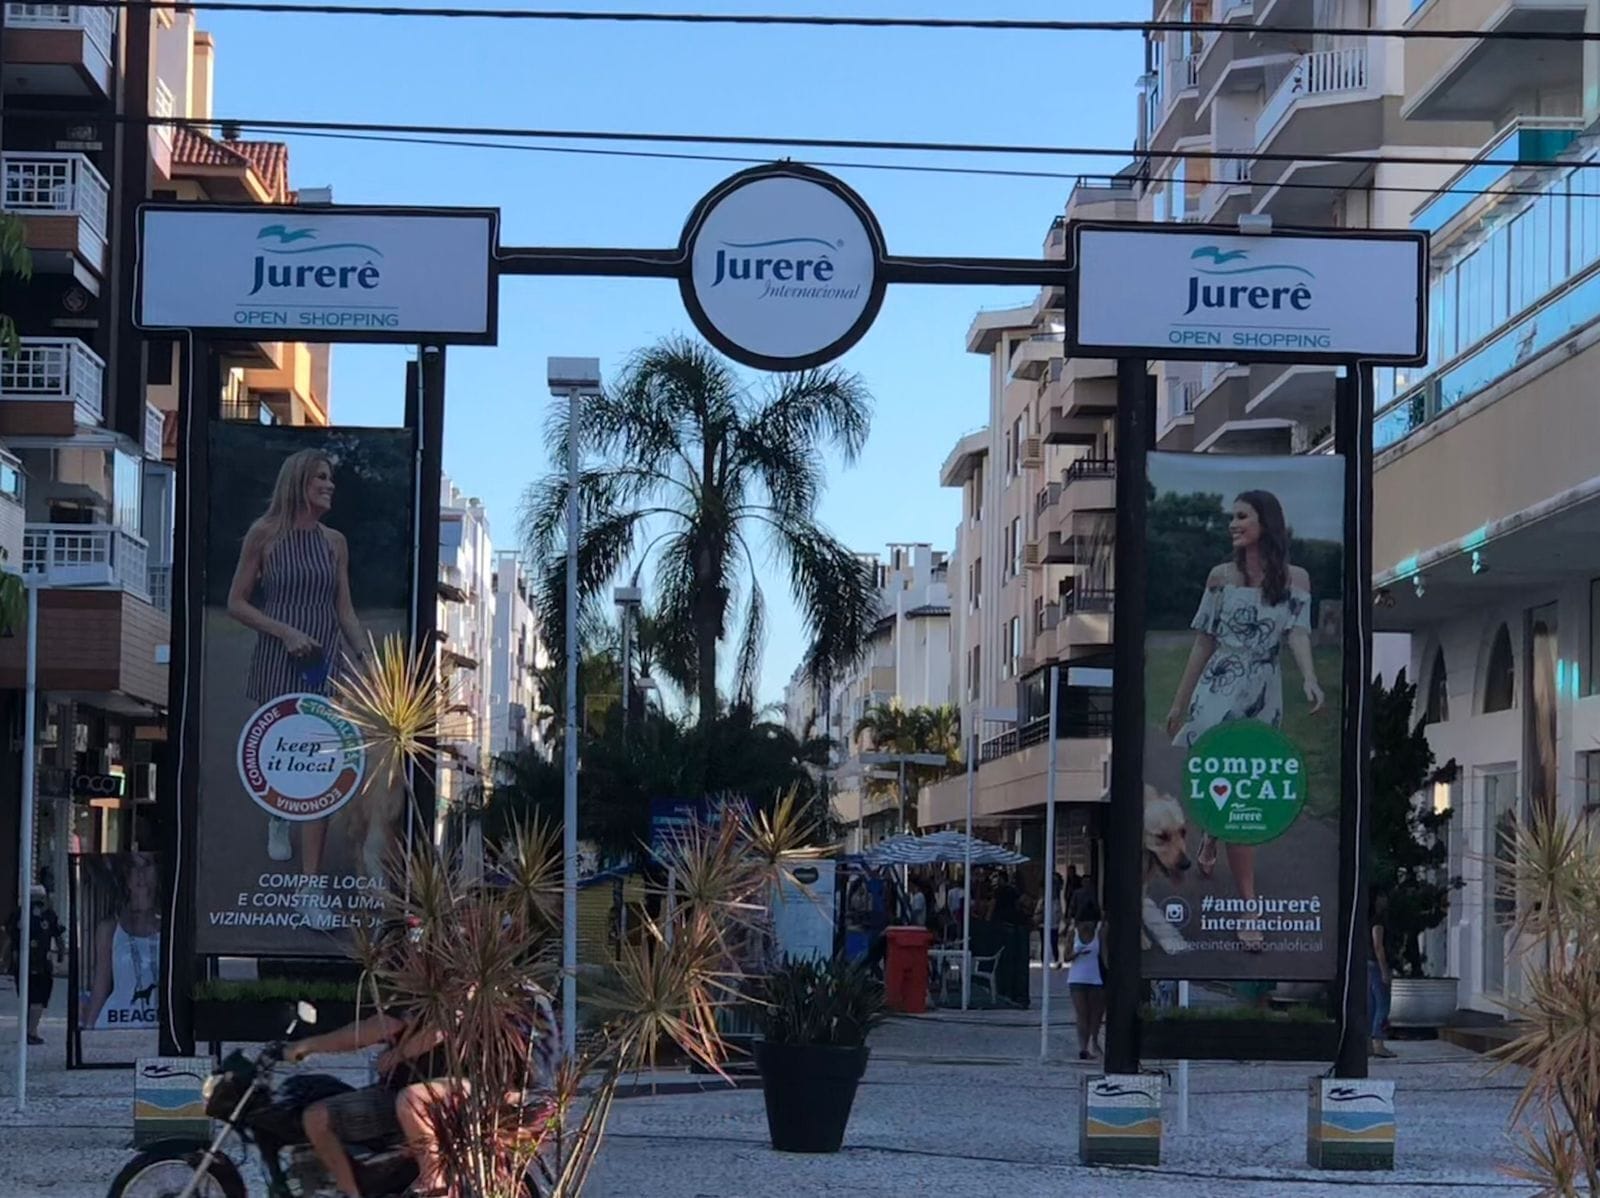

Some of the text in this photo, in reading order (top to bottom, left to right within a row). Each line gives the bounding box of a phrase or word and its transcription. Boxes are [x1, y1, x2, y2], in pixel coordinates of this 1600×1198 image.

[248, 256, 380, 296] Jurerê
[710, 250, 834, 288] Jurerê
[758, 279, 861, 300] Internacional
[1183, 276, 1312, 316] Jurerê
[233, 311, 399, 327] OPEN SHOPPING
[1168, 330, 1331, 348] OPEN SHOPPING
[245, 706, 281, 786] COMUNIDADE
[276, 736, 321, 757] keep
[267, 755, 336, 773] it local
[1188, 757, 1299, 779] compre
[276, 788, 342, 812] ECONOMIA
[258, 873, 386, 890] COMPRE LOCAL
[238, 893, 386, 910] E CONSTRUA UMA
[1201, 895, 1321, 915] #amojurerê
[209, 912, 312, 929] VIZINHANÇA
[1201, 915, 1321, 931] internacional
[107, 1008, 157, 1023] BEAG
